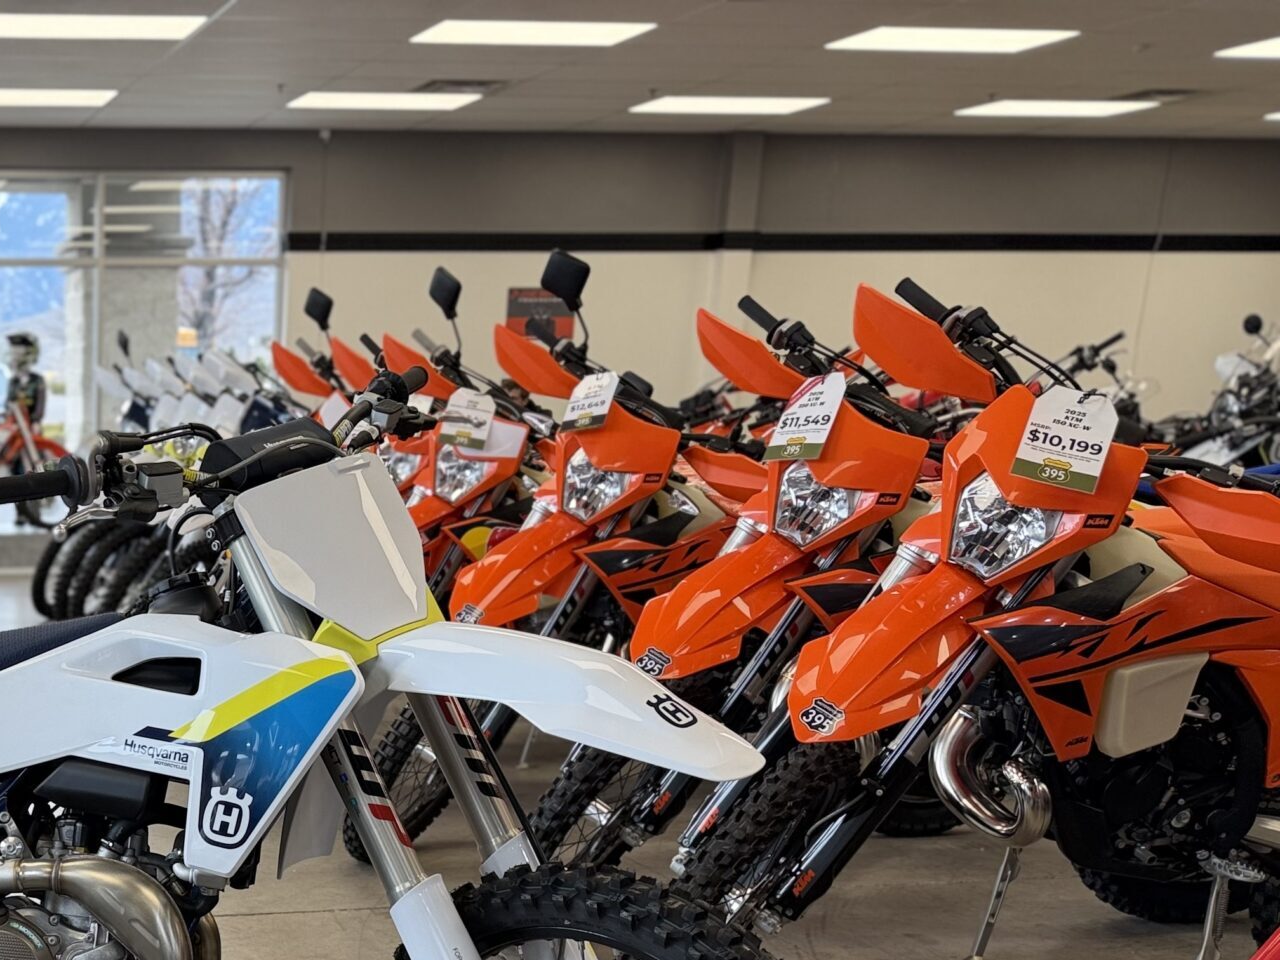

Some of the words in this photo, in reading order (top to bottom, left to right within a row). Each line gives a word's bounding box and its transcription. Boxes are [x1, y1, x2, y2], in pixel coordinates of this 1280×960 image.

[1064, 408, 1087, 418] 2025
[1064, 415, 1083, 424] KTM
[779, 414, 831, 429] $11,549
[1052, 418, 1067, 426] 150
[1027, 428, 1103, 456] $10,199
[784, 445, 801, 455] 395
[1041, 466, 1065, 481] 395
[1086, 517, 1109, 526] KTM
[637, 656, 662, 676] 395
[802, 709, 833, 732] 395
[124, 739, 189, 763] Husqvarna
[154, 760, 188, 771] MOTORCYCLES
[792, 868, 815, 897] KTM
